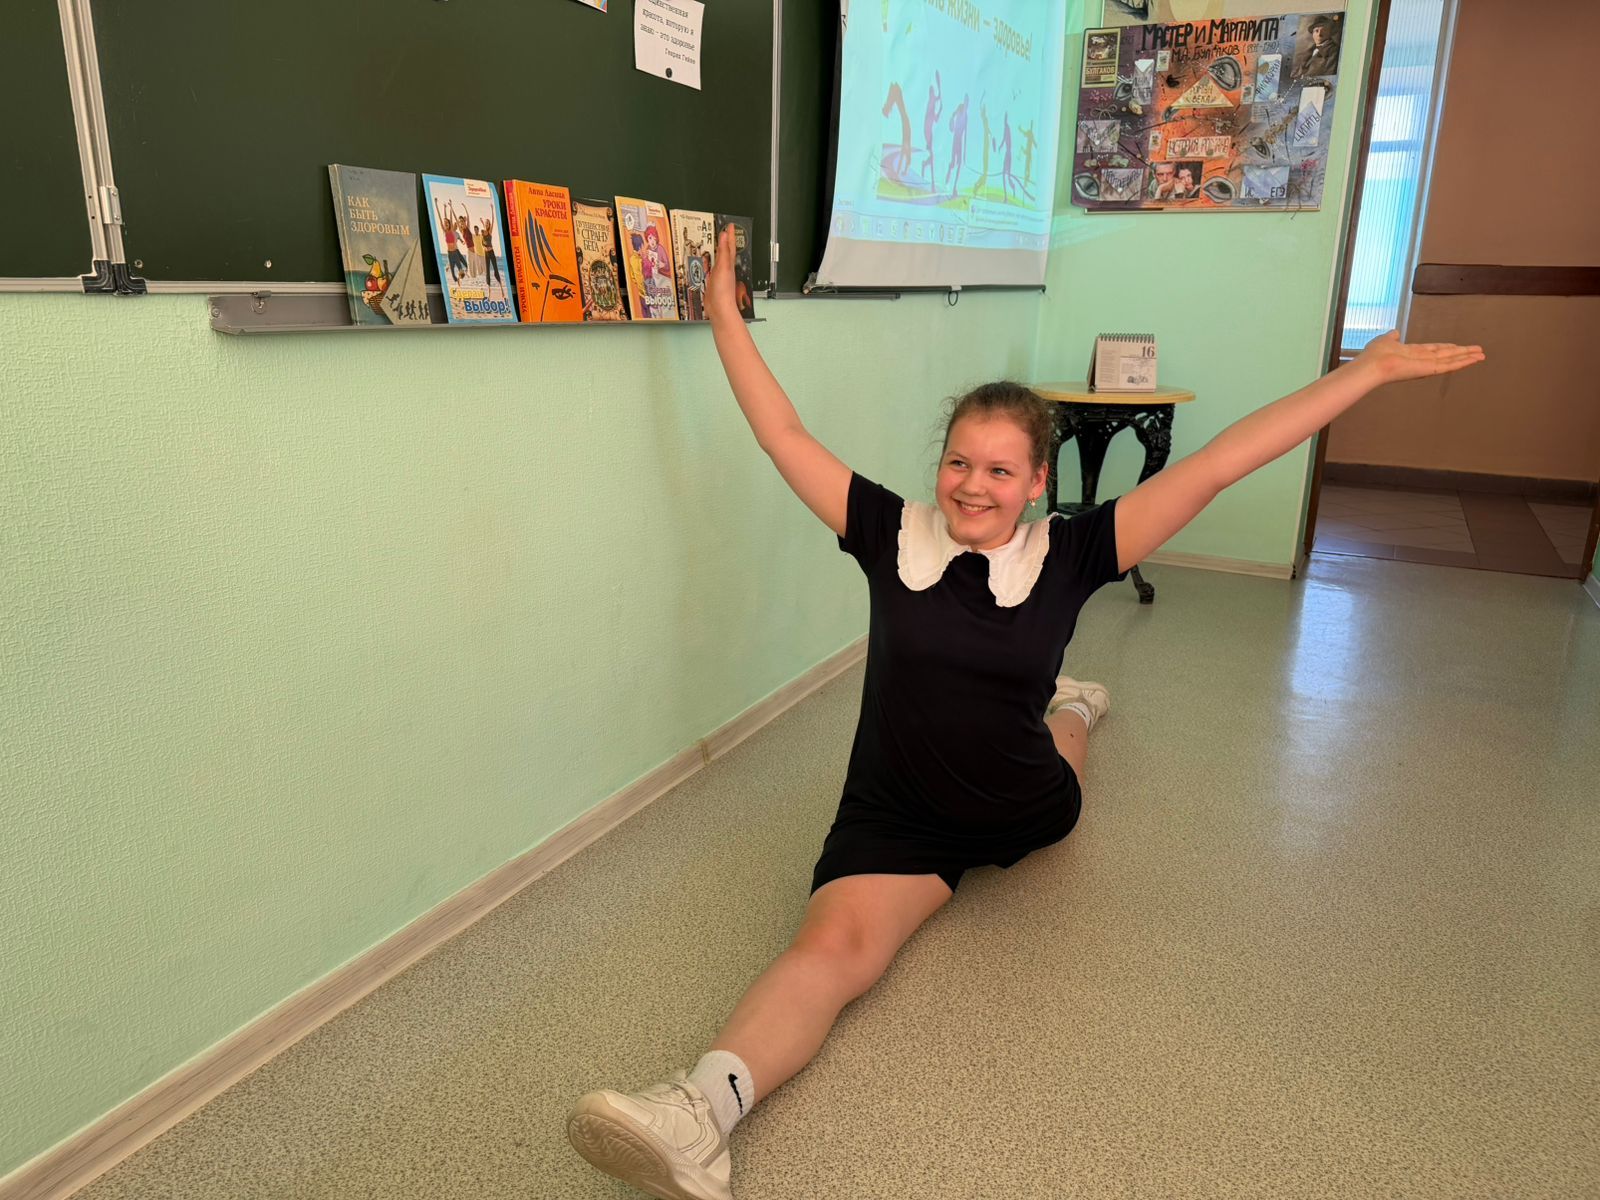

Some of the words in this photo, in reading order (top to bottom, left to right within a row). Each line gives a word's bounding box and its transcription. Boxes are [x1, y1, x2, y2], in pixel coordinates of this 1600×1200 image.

[1295, 111, 1322, 142] ЦИТАТЫ
[1270, 186, 1286, 198] ЕГЭ
[347, 195, 370, 209] КАК
[543, 199, 567, 210] УРОКИ
[349, 208, 378, 221] БЫТЬ
[535, 208, 567, 220] КРАСОТЫ
[350, 220, 410, 236] ЗДОРОВЫМ
[514, 246, 524, 284] КРАСОТЫ
[519, 286, 527, 313] УРОКИ
[1142, 346, 1155, 358] 16
